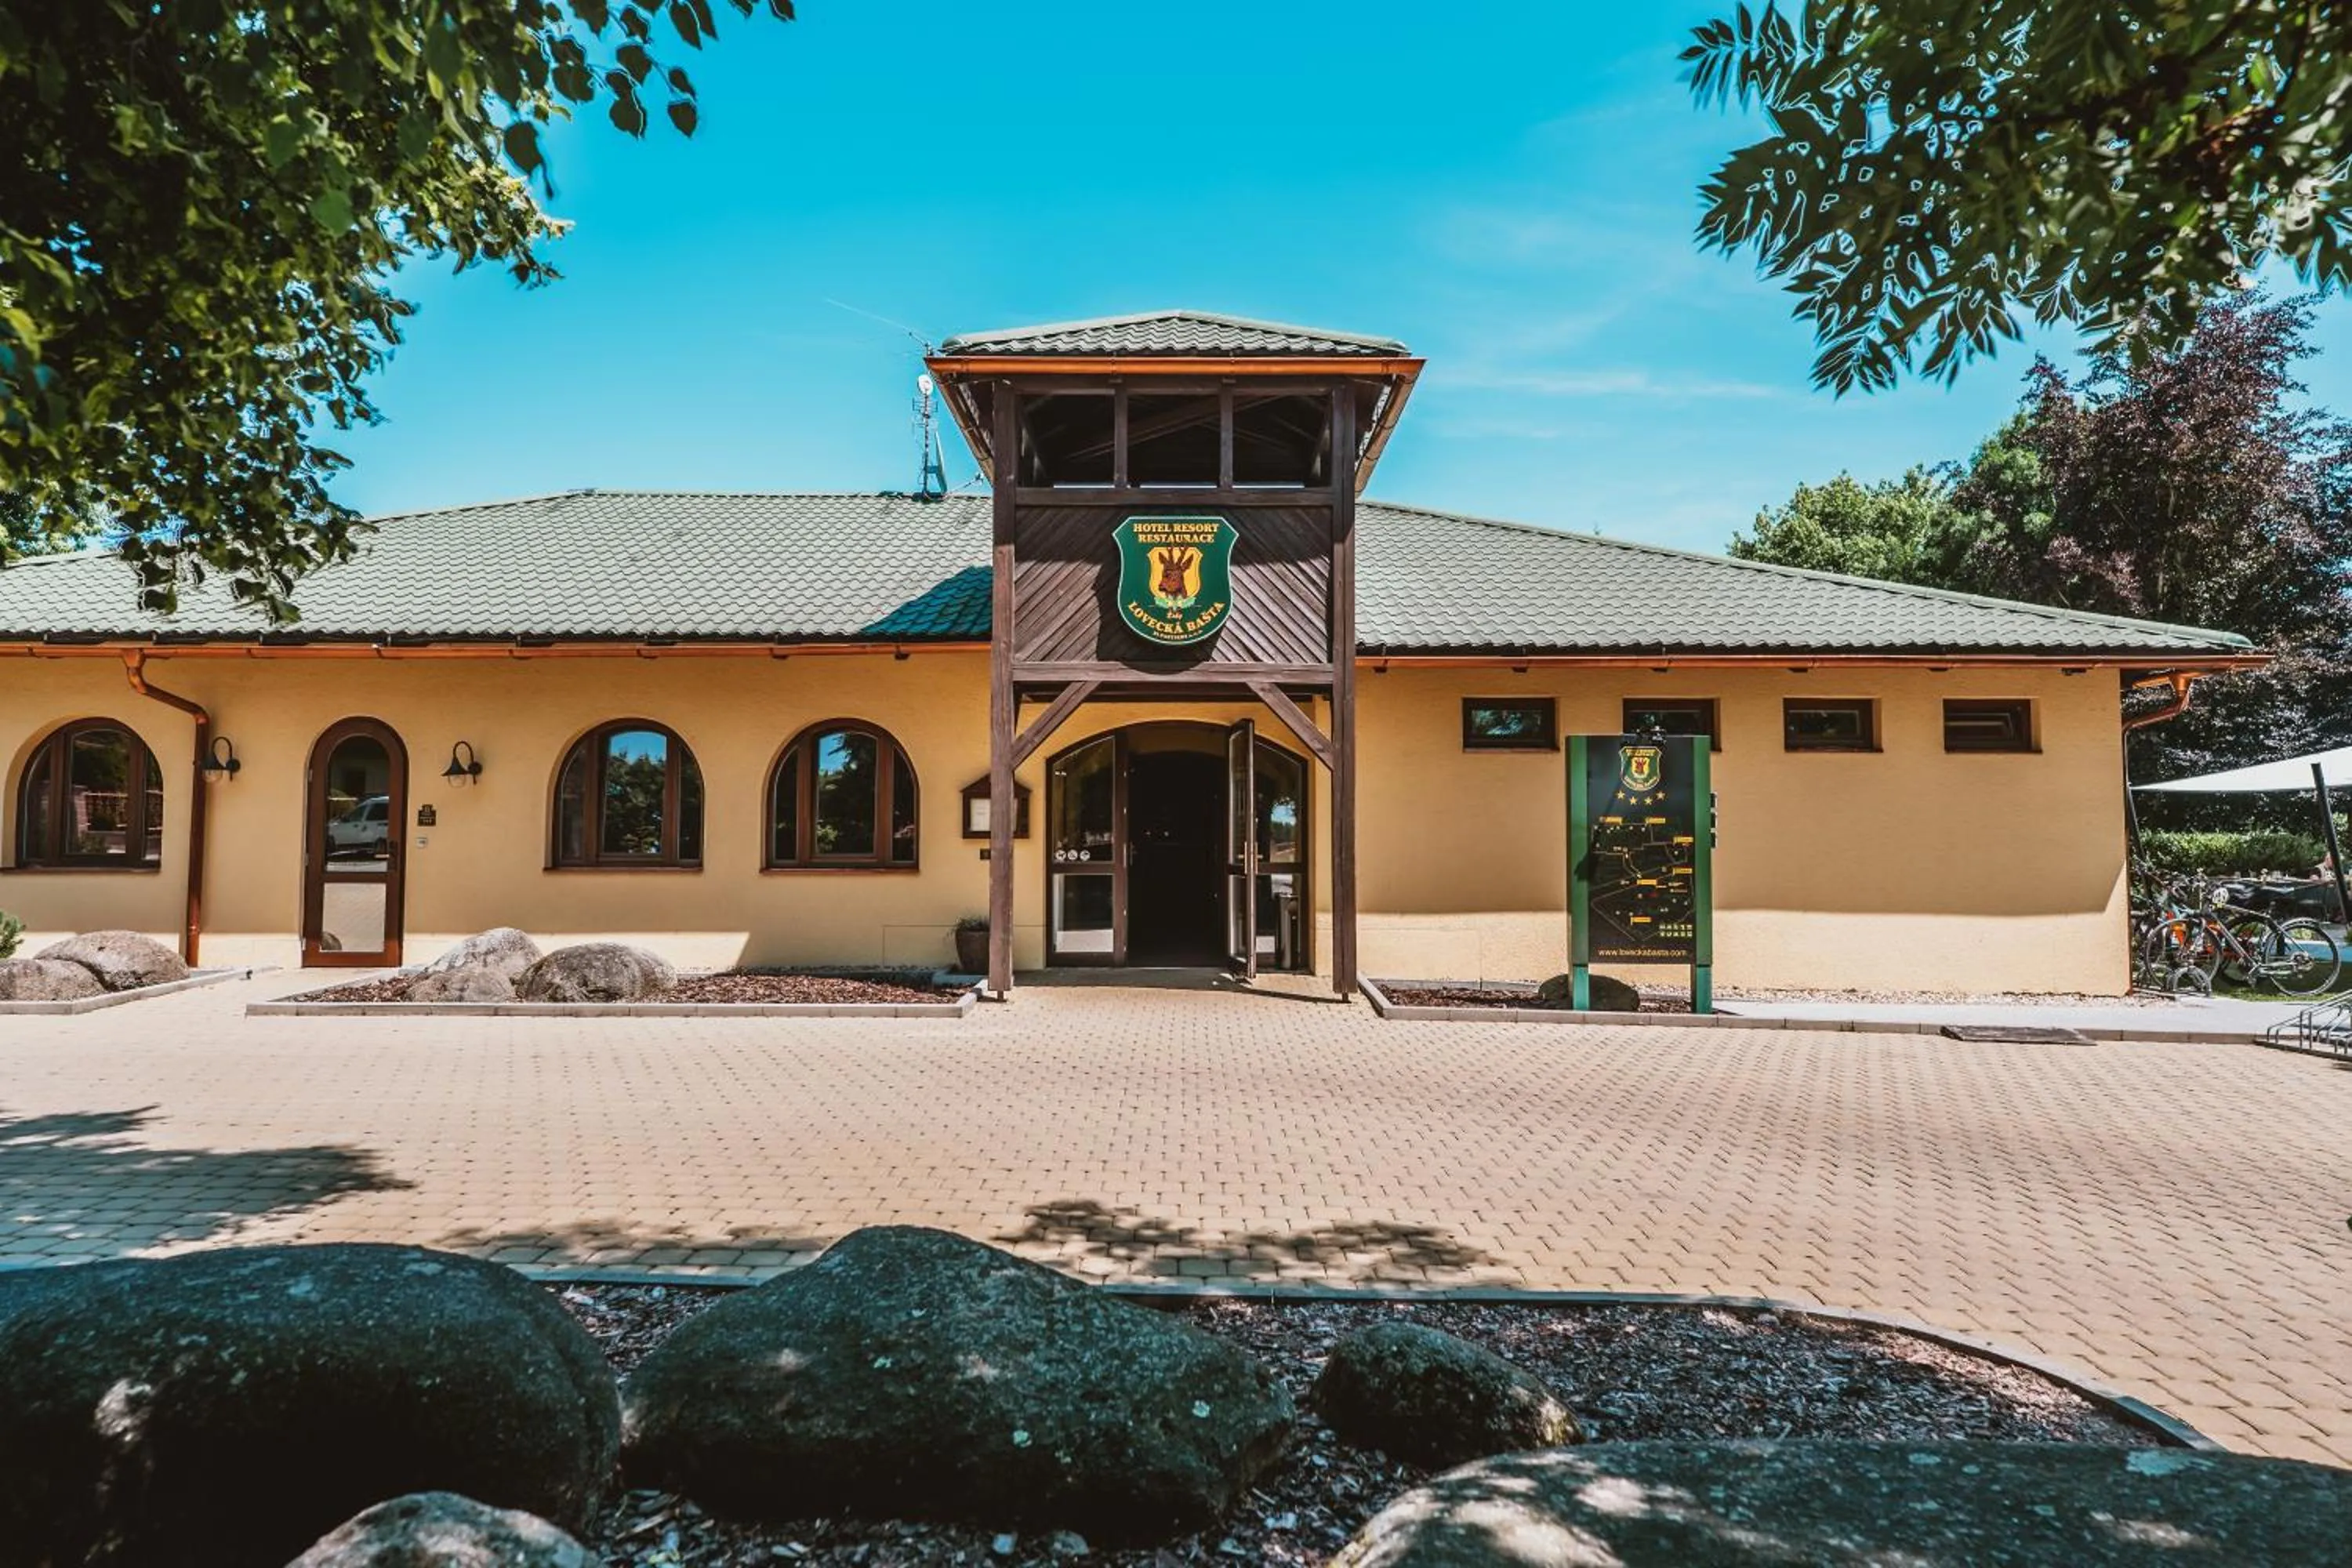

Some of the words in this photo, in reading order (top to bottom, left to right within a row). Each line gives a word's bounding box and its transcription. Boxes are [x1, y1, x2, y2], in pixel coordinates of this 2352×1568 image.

[1133, 524, 1171, 532] HOTEL
[1174, 523, 1219, 532] RESORT
[1138, 534, 1214, 543] RESTAURACE
[1127, 601, 1183, 633] LOVECKÁ
[1185, 602, 1225, 631] BAŠTA
